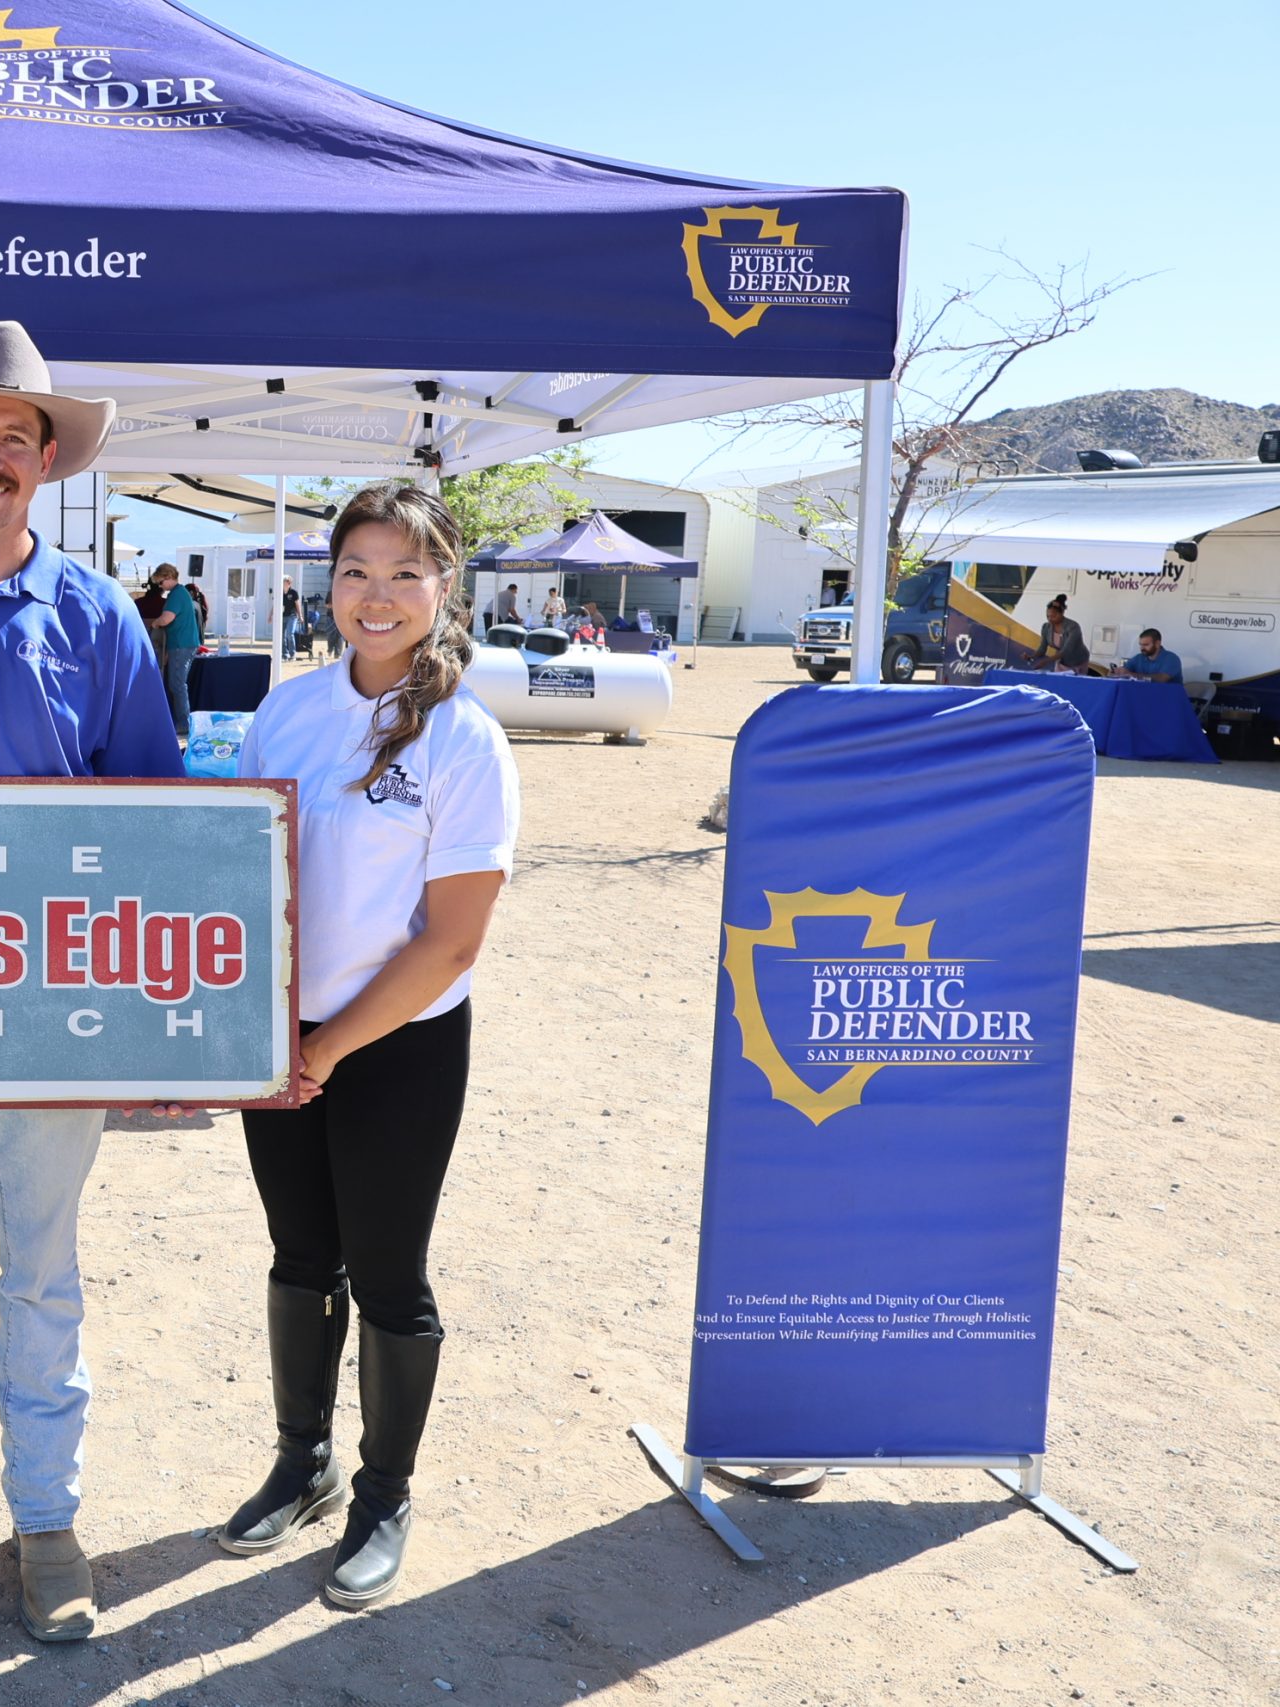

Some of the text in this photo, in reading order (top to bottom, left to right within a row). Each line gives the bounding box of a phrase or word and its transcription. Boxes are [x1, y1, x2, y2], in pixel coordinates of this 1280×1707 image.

[34, 50, 62, 59] OF
[67, 49, 111, 57] THE
[119, 112, 227, 128] COUNTY
[797, 248, 814, 256] THE
[729, 256, 813, 273] PUBLIC
[728, 274, 851, 293] DEFENDER
[749, 295, 809, 304] BERNARDINO
[811, 297, 850, 305] COUNTY
[1110, 578, 1139, 590] Works
[1139, 575, 1179, 595] Here
[1198, 614, 1267, 627] SBCounty.gov/Jobs
[377, 783, 422, 802] DEFENDER
[43, 896, 246, 1003] Edge
[813, 965, 965, 977] LAW OFFICES OF THE
[810, 978, 965, 1009] PUBLIC
[808, 1011, 1034, 1041] DEFENDER
[807, 1049, 1033, 1061] SAN BERNARDINO COUNTY
[727, 1294, 1004, 1308] To Defend the Rights and Dignity of Our Clients
[696, 1312, 1031, 1326] and to Ensure Equitable Access to Justice Through Holistic
[779, 1330, 813, 1340] While
[816, 1329, 878, 1342] Reunifying
[882, 1329, 929, 1339] Families
[932, 1329, 954, 1339] and
[957, 1329, 1036, 1340] Communities
